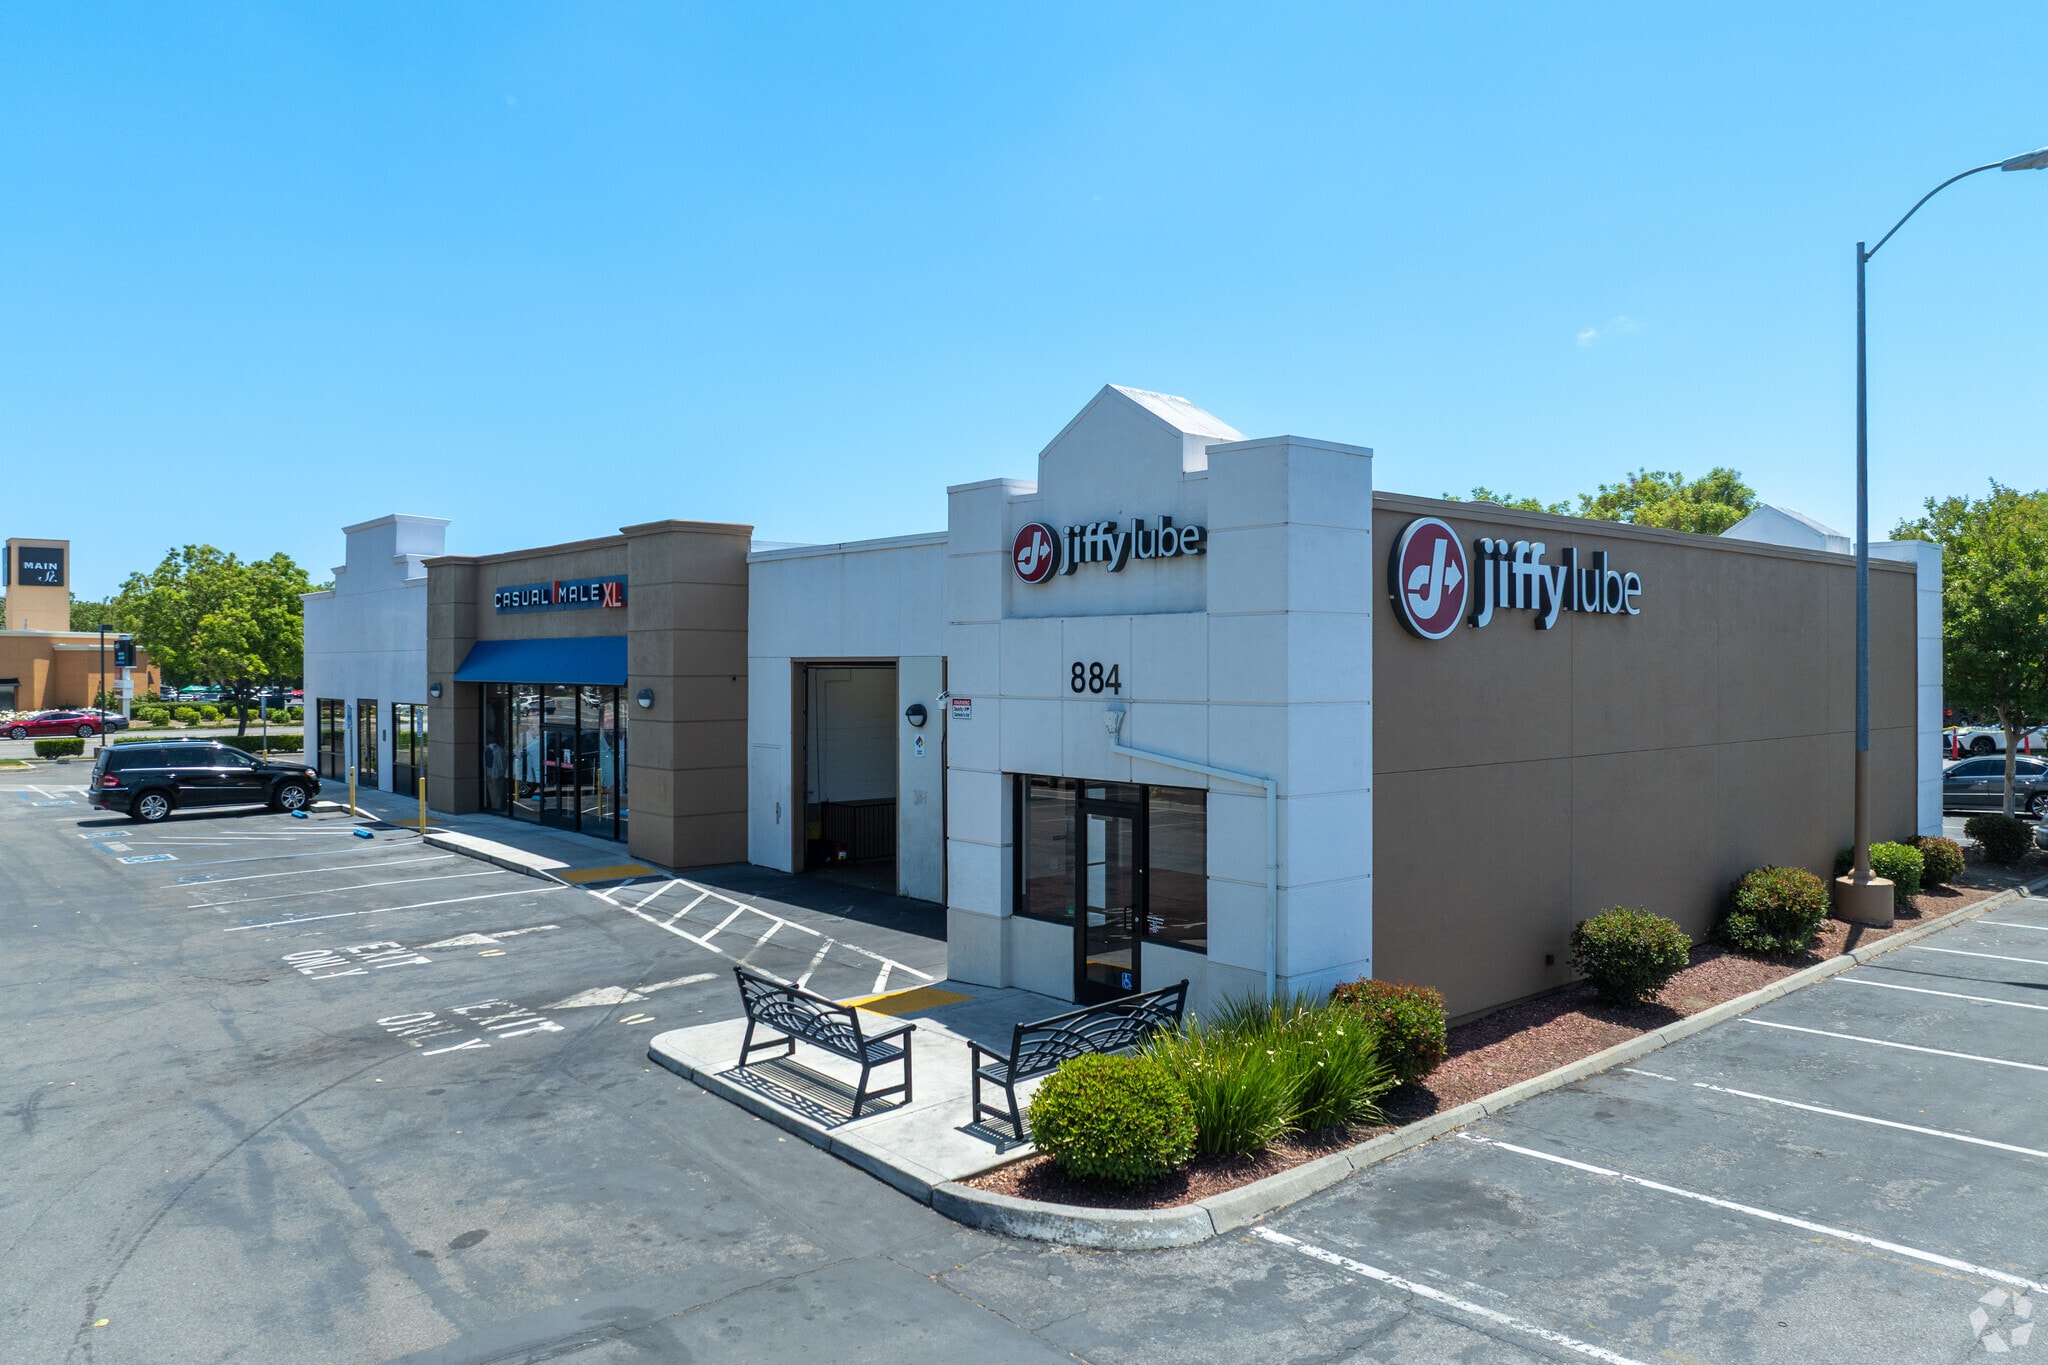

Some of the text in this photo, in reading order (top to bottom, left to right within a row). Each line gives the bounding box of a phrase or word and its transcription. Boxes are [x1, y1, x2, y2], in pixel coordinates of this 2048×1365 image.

[24, 561, 58, 570] MAIN
[494, 582, 622, 608] CASUAL MALE XL
[1071, 661, 1122, 696] 884
[281, 950, 369, 980] ONLY
